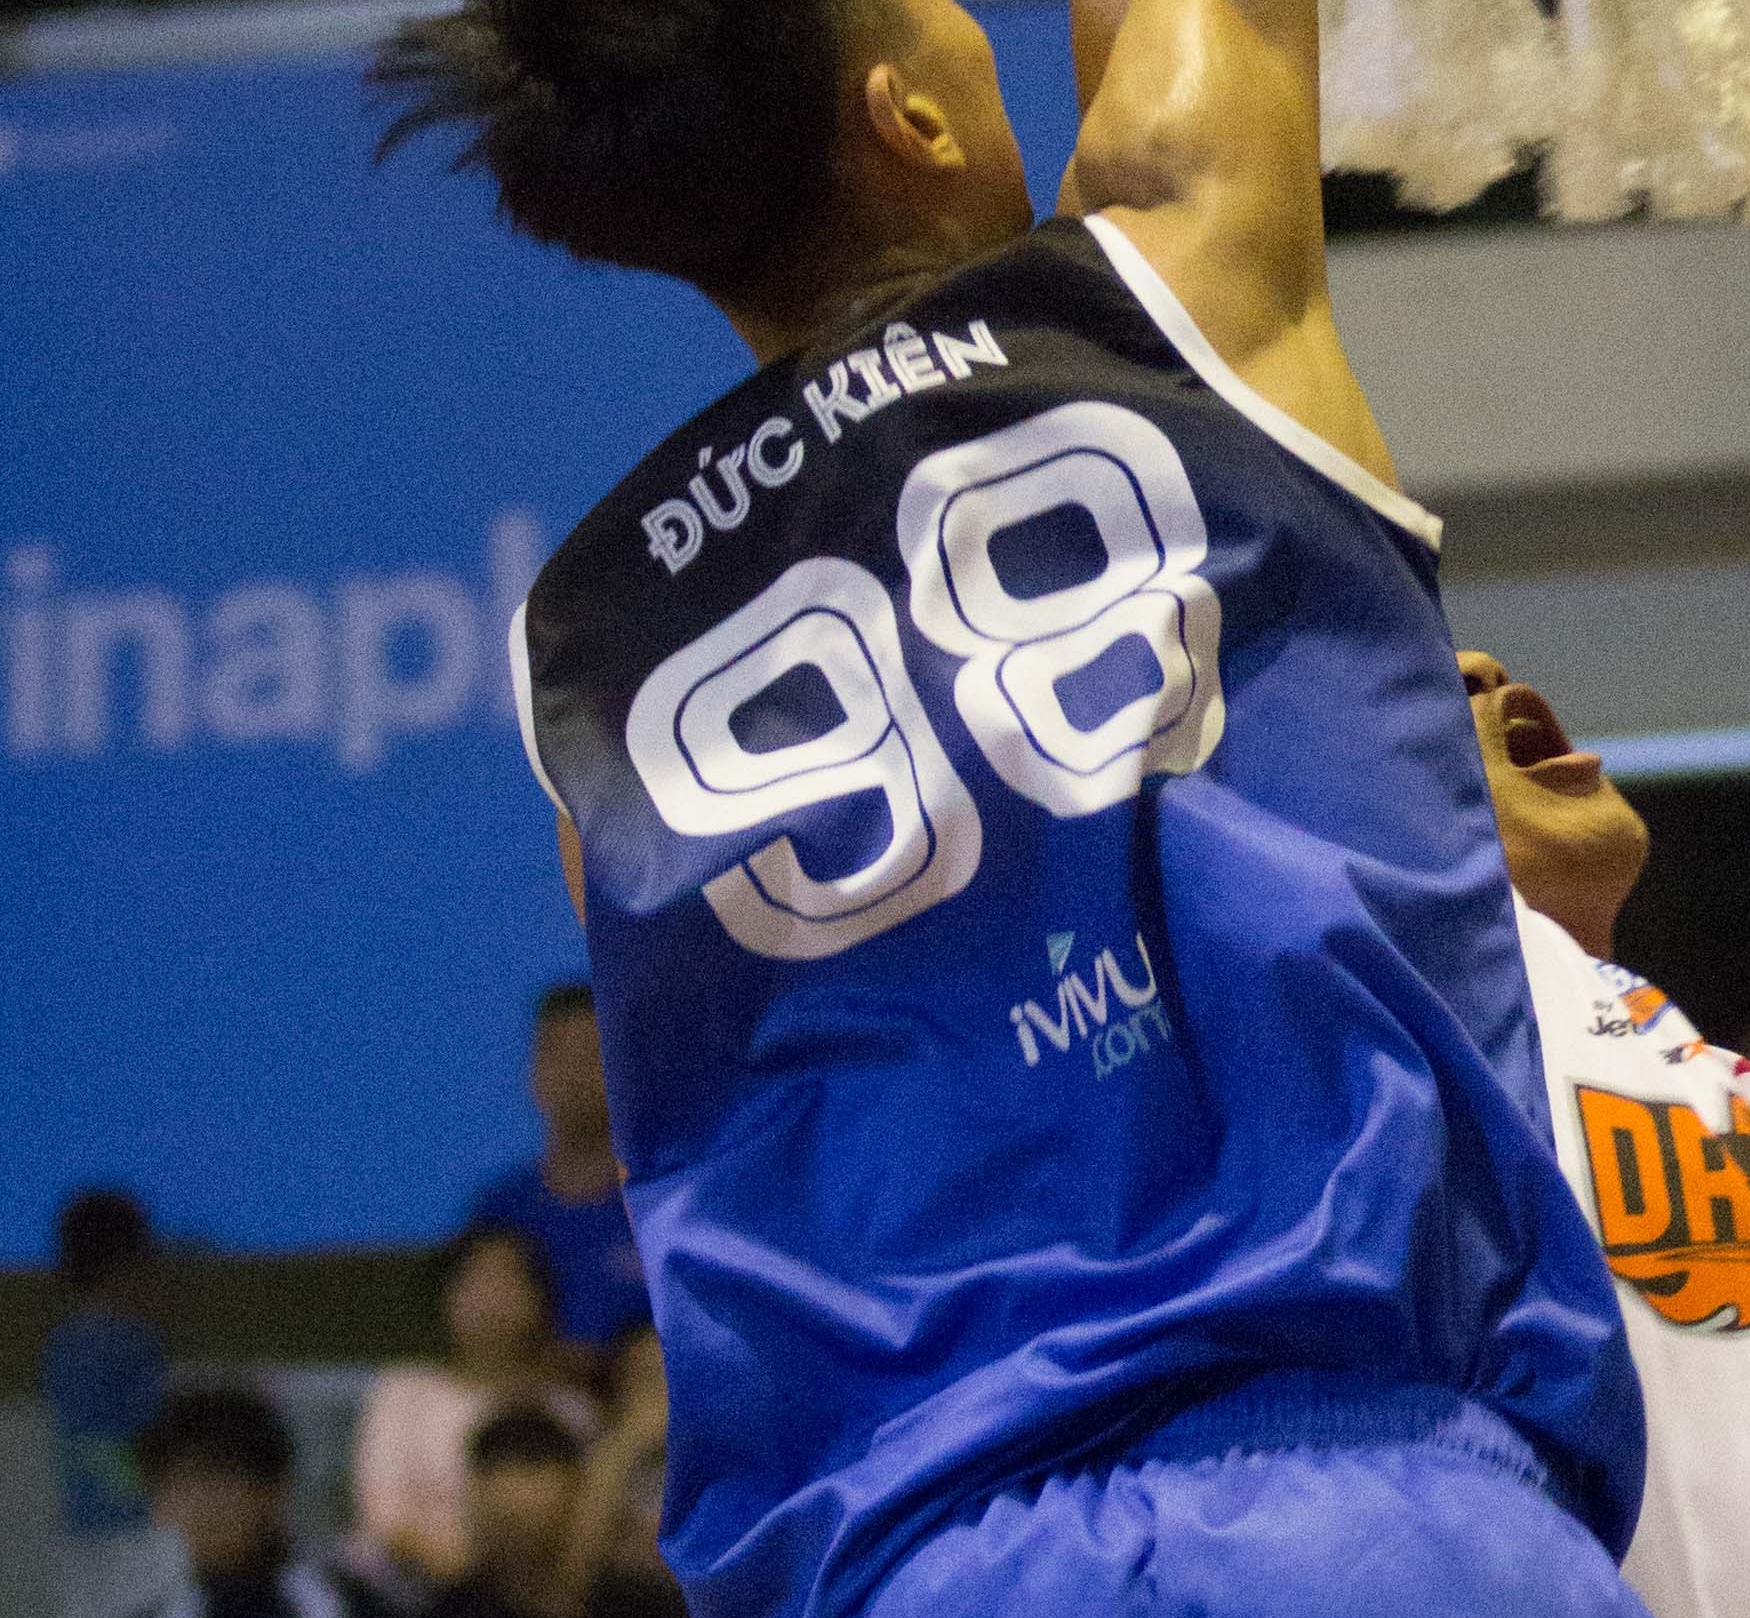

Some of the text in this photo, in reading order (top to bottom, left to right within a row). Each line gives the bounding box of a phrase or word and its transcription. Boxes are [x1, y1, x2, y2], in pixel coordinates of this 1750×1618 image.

[640, 319, 1008, 575] ĐỨC KIÊN
[626, 400, 1225, 961] 98
